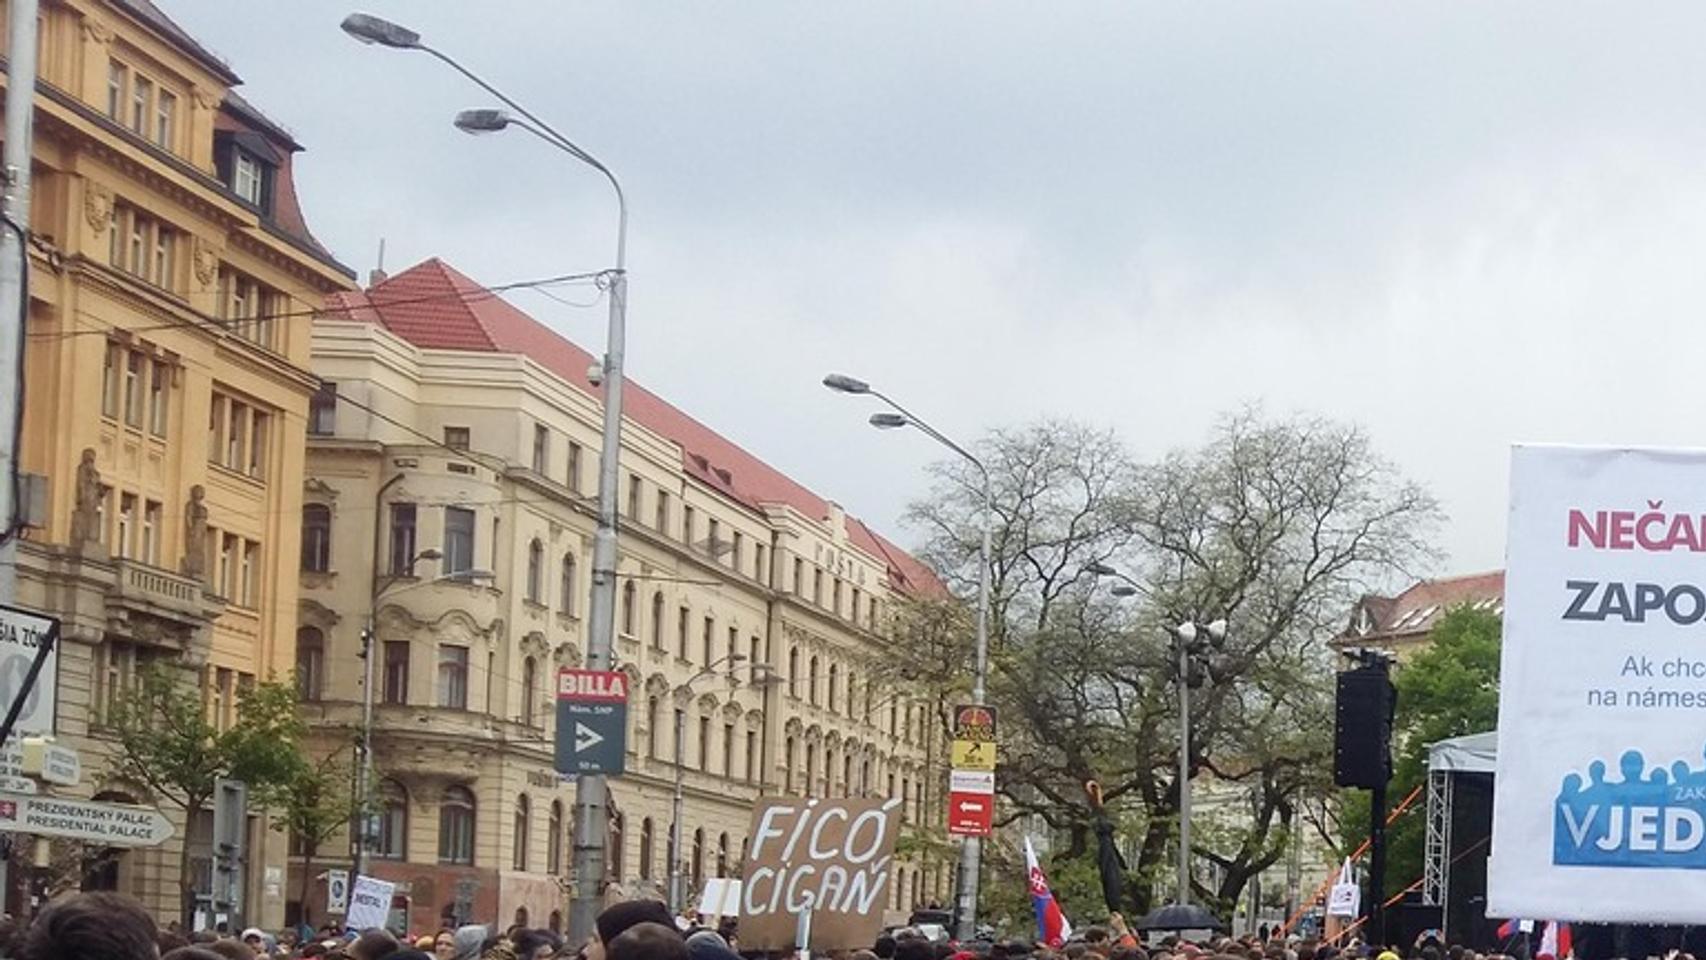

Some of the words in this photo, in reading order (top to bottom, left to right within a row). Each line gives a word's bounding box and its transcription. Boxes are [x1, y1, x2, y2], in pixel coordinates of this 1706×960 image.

[1620, 656, 1653, 677] Ak
[560, 673, 626, 697] BILLA
[1588, 690, 1617, 707] na
[26, 815, 107, 834] PRESIDENTIAL
[109, 825, 153, 839] PALACE
